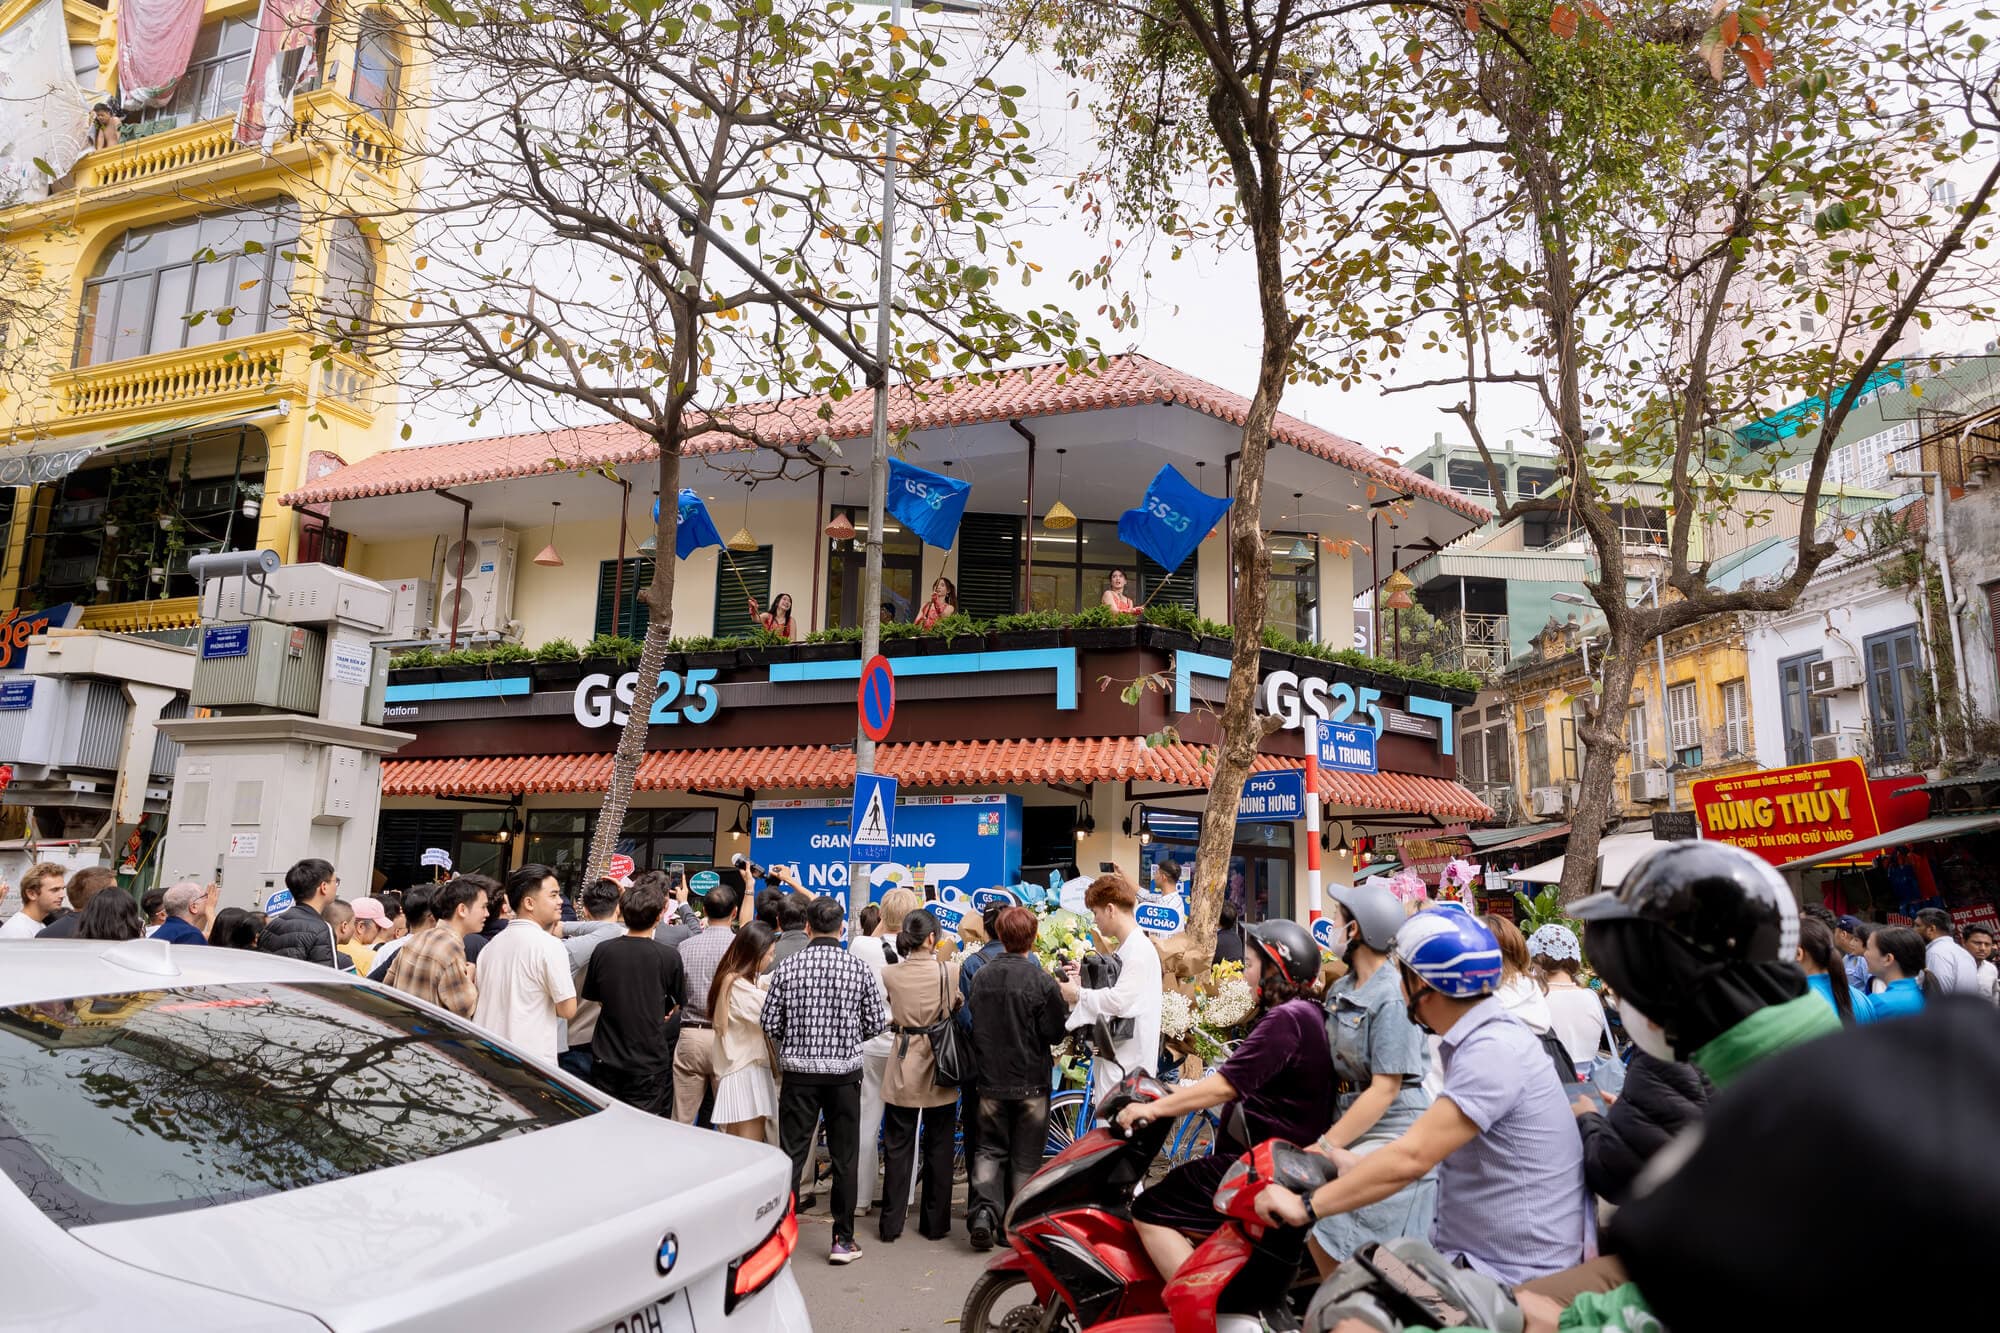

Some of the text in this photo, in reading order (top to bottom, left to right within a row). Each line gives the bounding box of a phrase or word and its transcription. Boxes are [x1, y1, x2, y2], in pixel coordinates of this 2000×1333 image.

[574, 669, 719, 728] GS25
[1266, 670, 1383, 741] GS25
[1335, 731, 1355, 743] PHỐ
[1322, 741, 1371, 766] HÀ TRUNG
[1251, 778, 1276, 791] PHỐ
[1239, 793, 1296, 813] HÙNG HƯNG
[1705, 783, 1850, 832] HÙNG THÚY
[811, 833, 936, 849] GRAN NING
[1760, 832, 1776, 847] TÍN
[1776, 833, 1801, 846] HƠN
[1801, 830, 1821, 844] GIỮ
[1822, 827, 1854, 842] VÀNG
[935, 907, 958, 921] GS25
[1139, 916, 1153, 925] XIN
[1147, 907, 1169, 918] GS25
